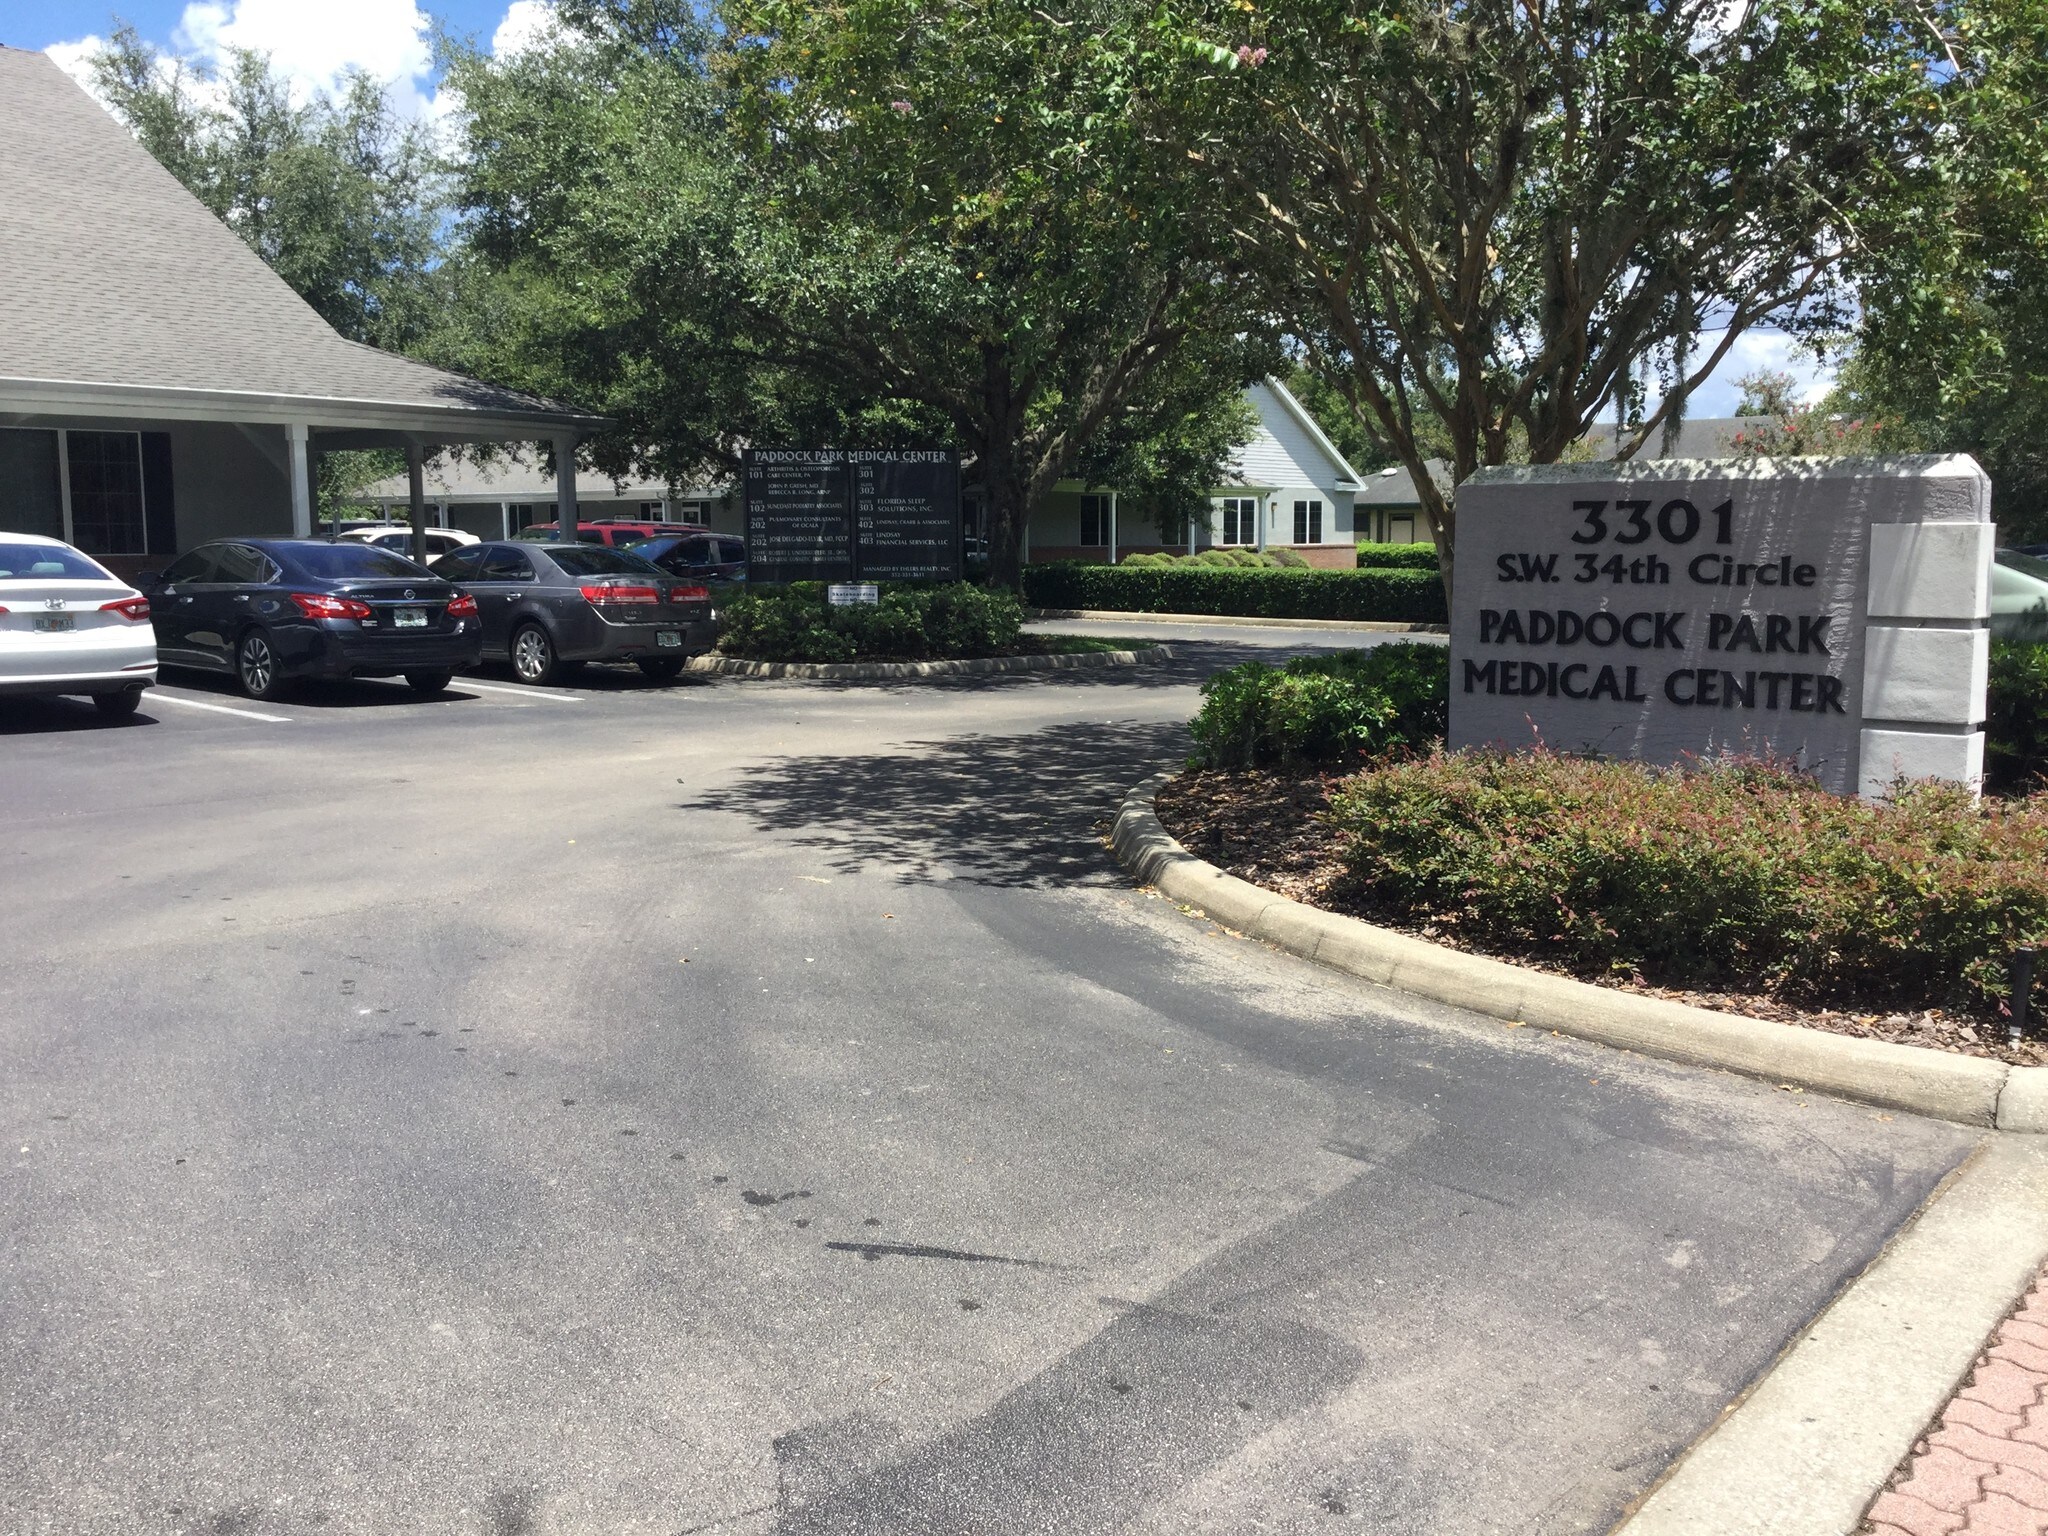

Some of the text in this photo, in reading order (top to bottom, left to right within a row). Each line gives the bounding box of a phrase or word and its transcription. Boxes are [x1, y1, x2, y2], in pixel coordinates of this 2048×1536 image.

[755, 451, 947, 461] PADDOCK PARK MEDICAL CENTER
[859, 470, 873, 478] 301
[1571, 499, 1733, 545] 3301
[1497, 553, 1817, 588] S.W. 34th Circle
[1480, 609, 1834, 656] PADDOCK PARK
[1463, 659, 1848, 715] MEDICAL CENTER
